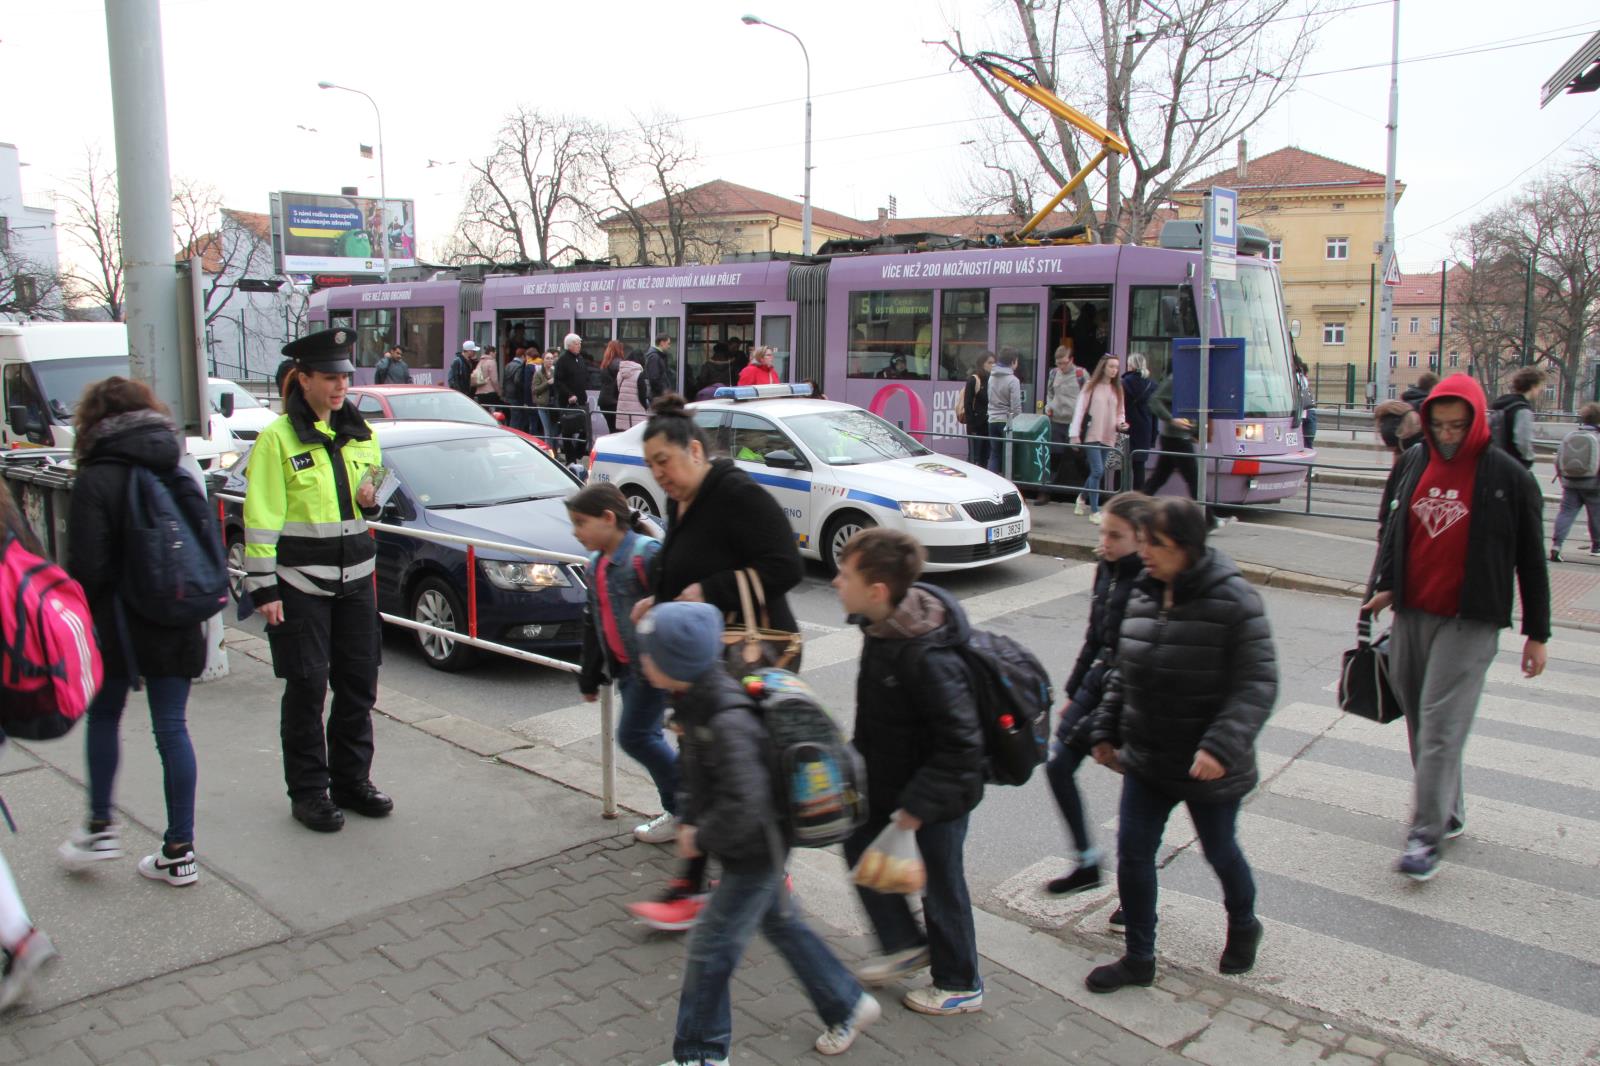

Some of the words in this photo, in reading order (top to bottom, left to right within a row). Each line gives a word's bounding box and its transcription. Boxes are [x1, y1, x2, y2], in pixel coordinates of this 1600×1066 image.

[882, 263, 901, 278] VÍCE
[902, 262, 921, 278] NEŽ
[922, 263, 941, 277] 200
[942, 259, 992, 276] MOŽNOSTÍ
[993, 260, 1012, 275] PRO
[1015, 257, 1035, 274] VÁŠ
[1036, 258, 1063, 273] STYL
[523, 282, 536, 295] VÍCE
[536, 281, 547, 294] NEŽ
[547, 282, 559, 294] 200
[559, 279, 582, 293] DŮVODŮ
[582, 280, 591, 292] SE
[591, 279, 616, 291] UKÁZAT
[622, 277, 637, 290] VÍCE
[637, 275, 652, 289] NEŽ
[651, 276, 665, 288] 200
[665, 273, 693, 288] DŮVODŮ
[693, 275, 699, 287] K
[699, 271, 717, 286] NÁM
[716, 271, 742, 286] PŘIJET
[862, 297, 870, 314] 5
